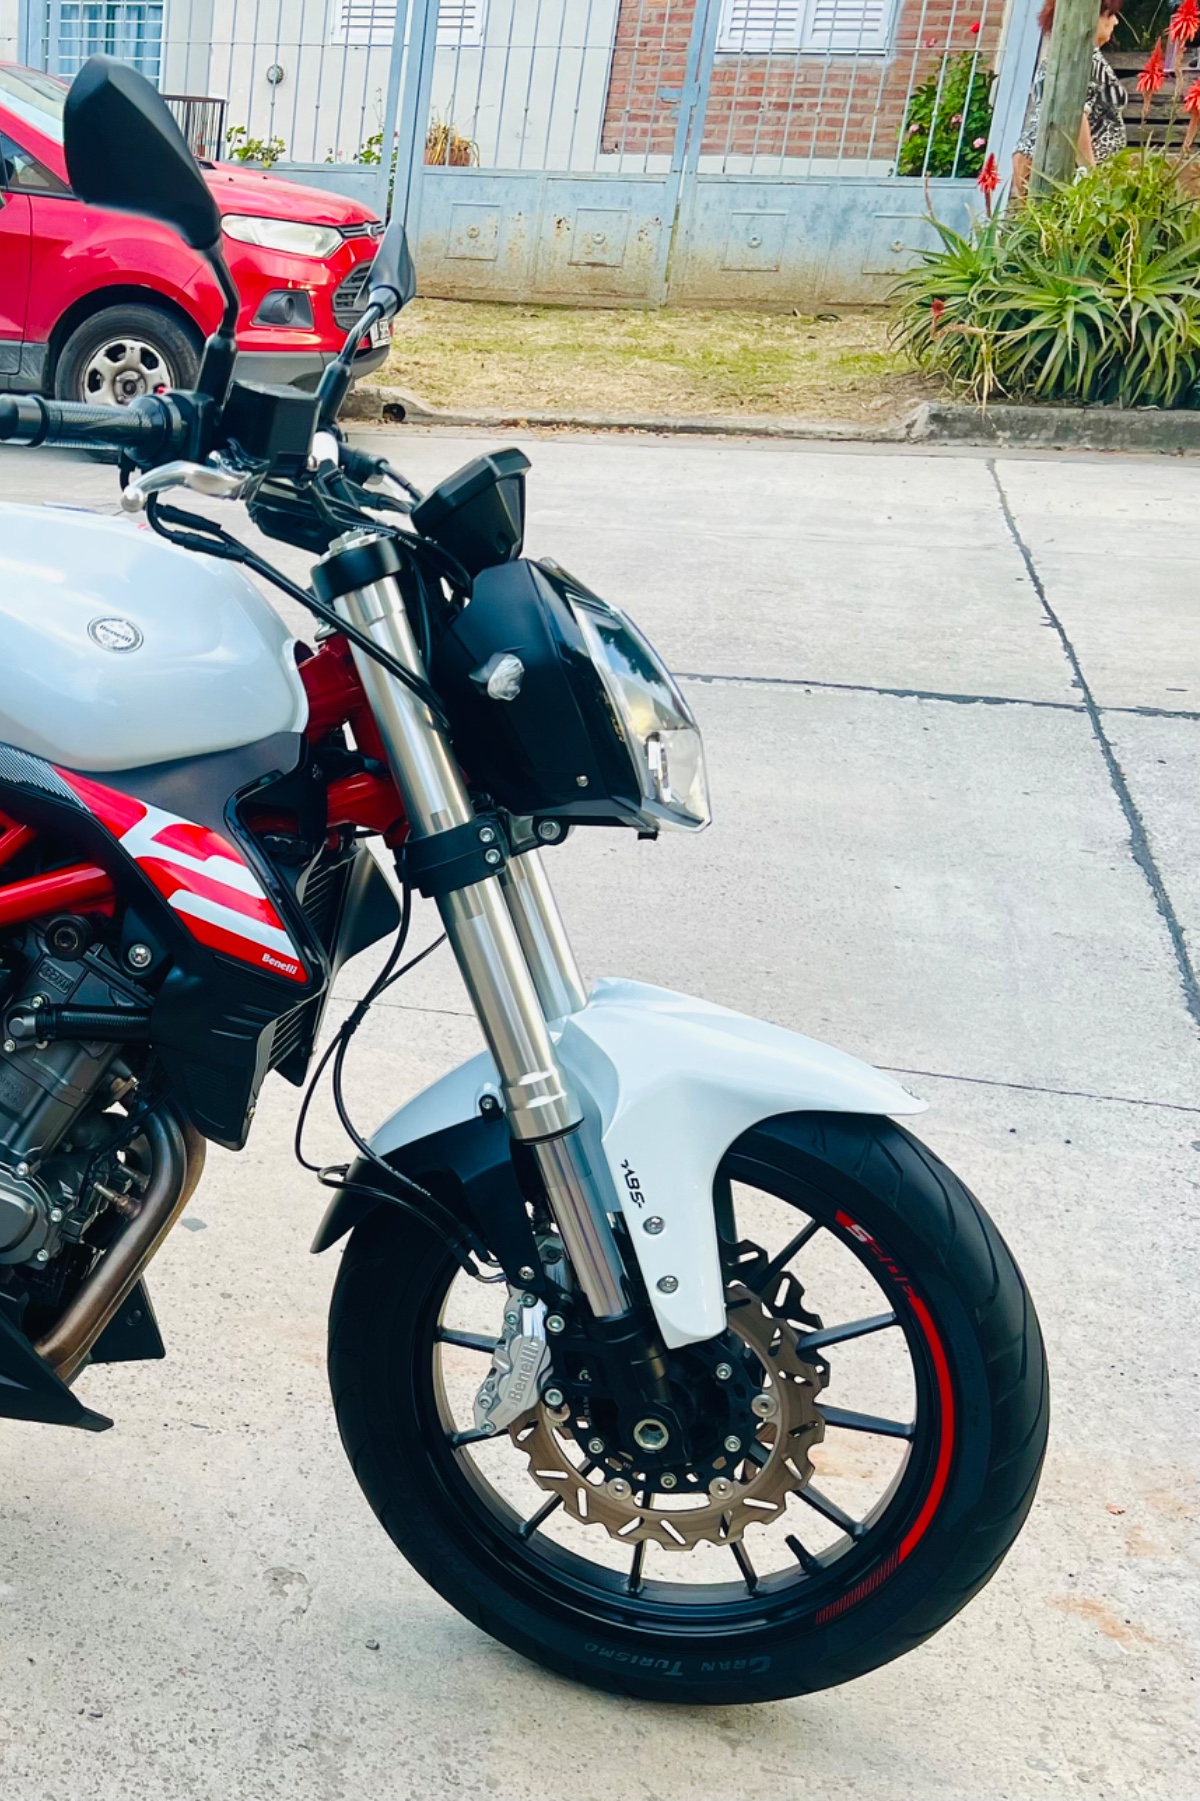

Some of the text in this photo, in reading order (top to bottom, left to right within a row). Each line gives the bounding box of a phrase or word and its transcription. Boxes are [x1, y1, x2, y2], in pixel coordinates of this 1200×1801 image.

[262, 952, 298, 975] Benelli
[621, 1159, 645, 1209] ABS
[507, 1341, 539, 1402] Benelli
